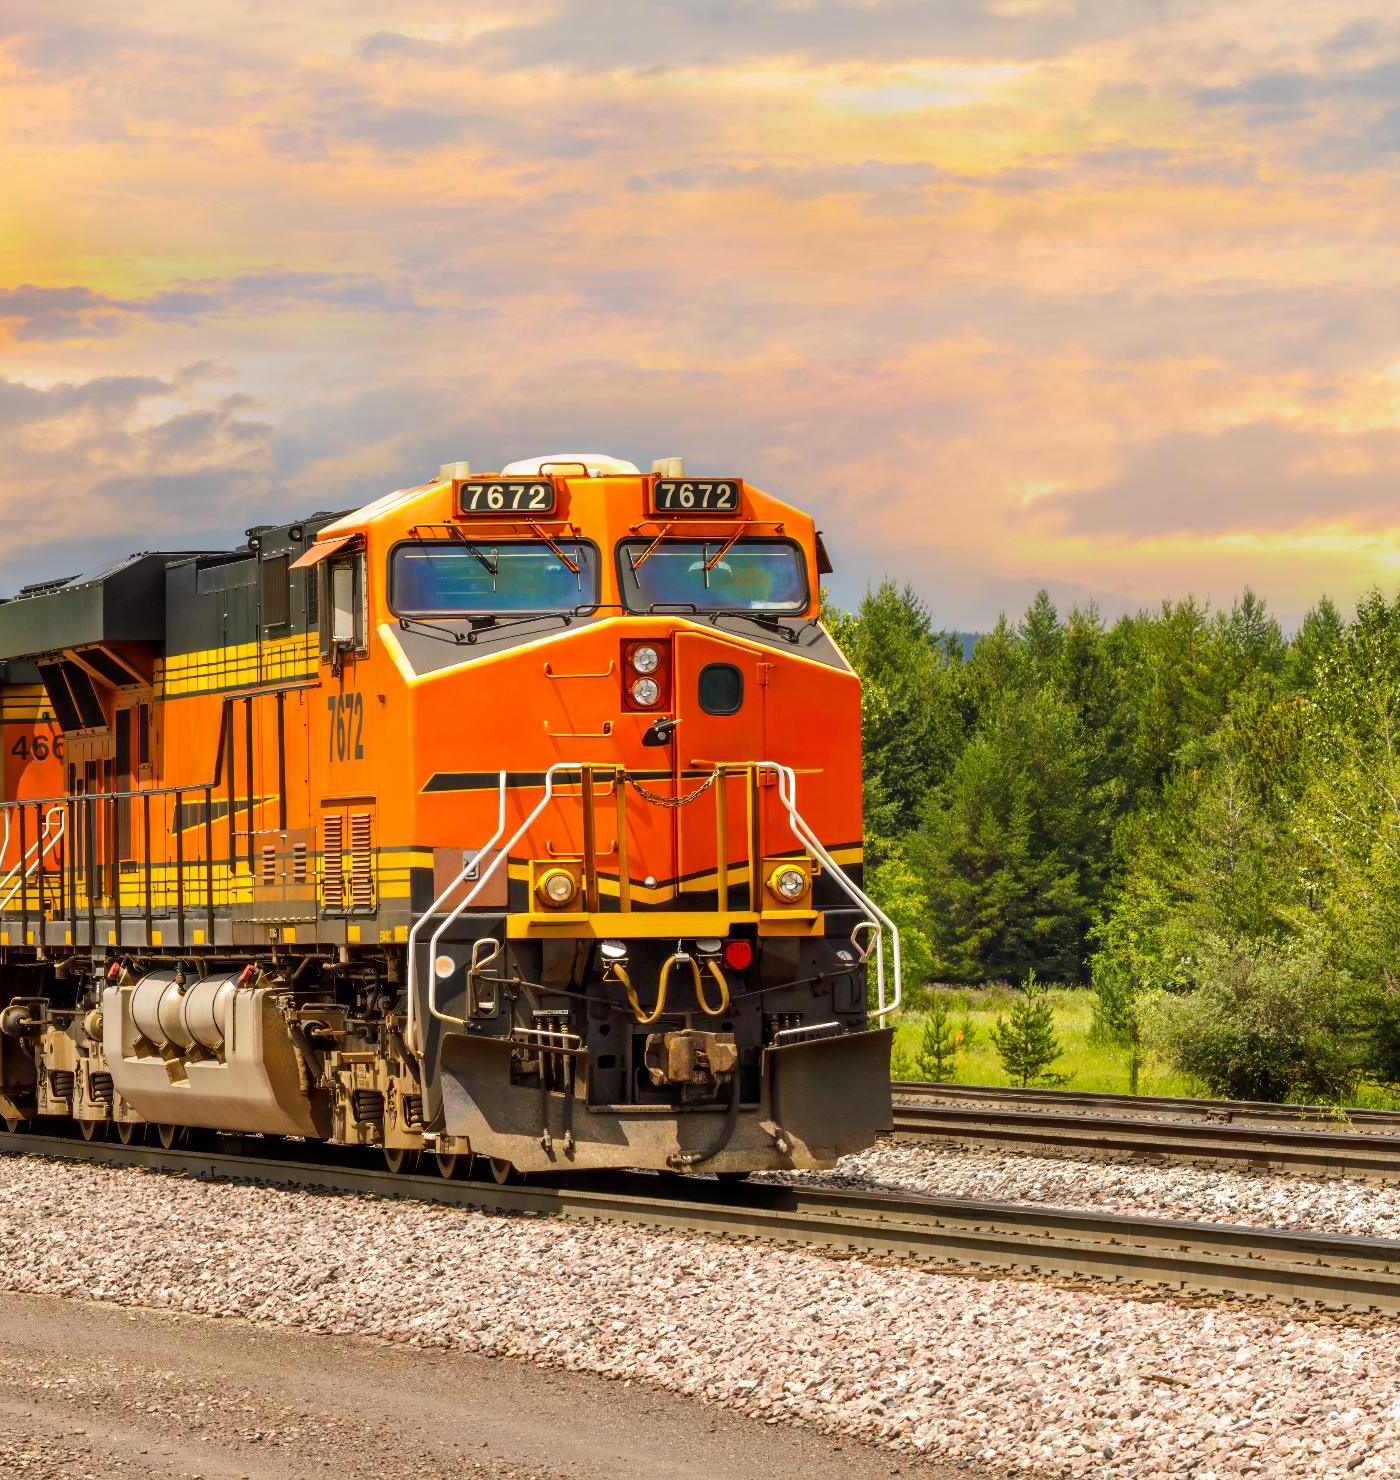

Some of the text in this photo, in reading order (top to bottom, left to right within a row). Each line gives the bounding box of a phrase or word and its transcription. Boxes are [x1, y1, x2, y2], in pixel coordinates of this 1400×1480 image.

[467, 484, 546, 510] 7672
[661, 483, 732, 508] 7672
[327, 691, 364, 763] 7672
